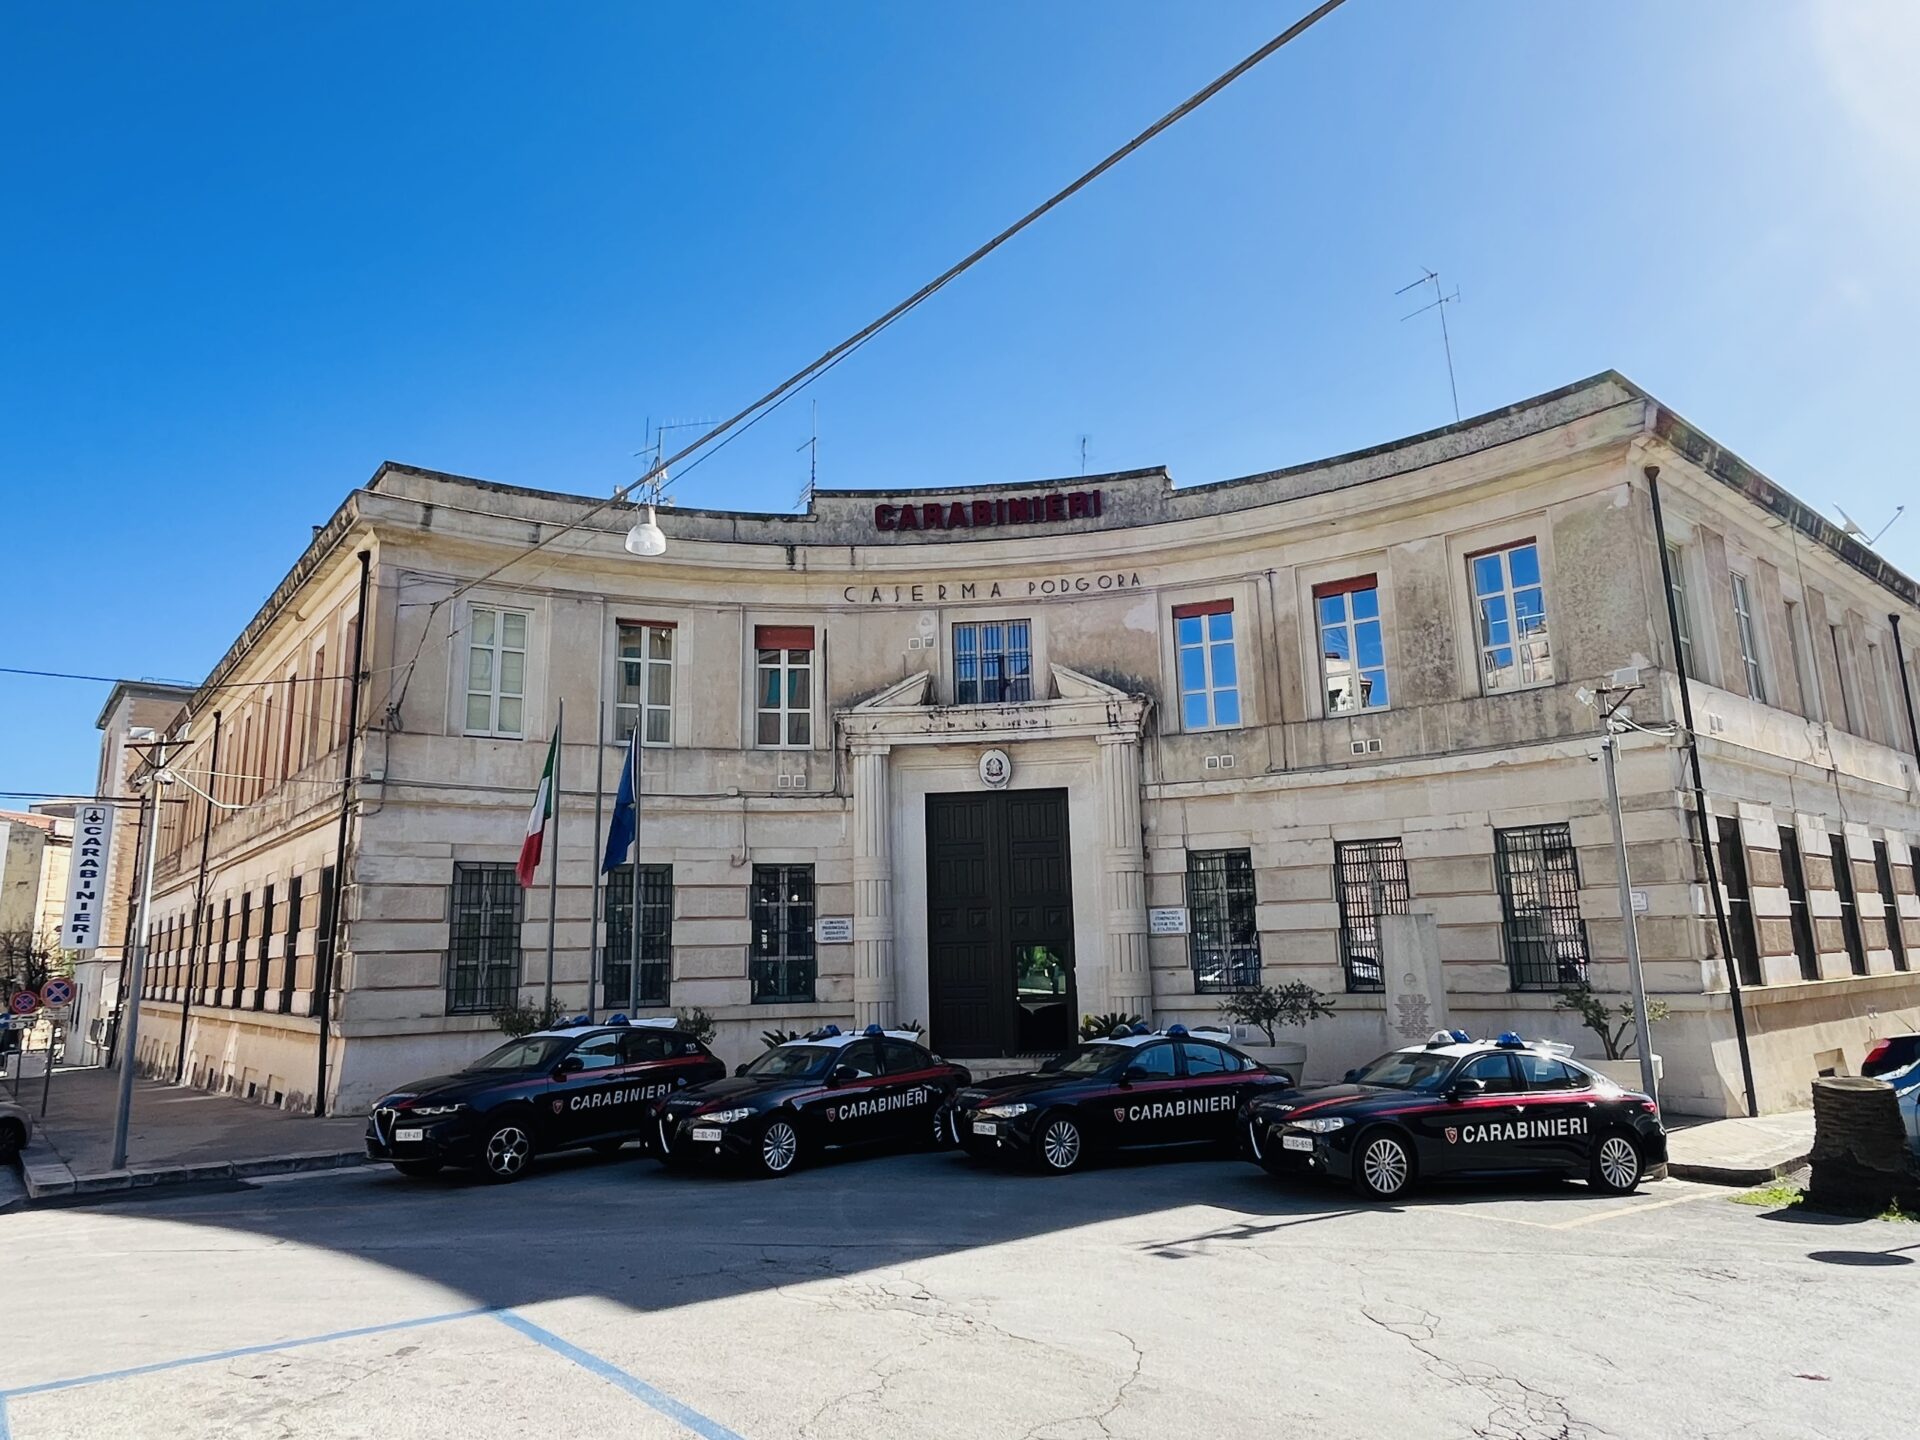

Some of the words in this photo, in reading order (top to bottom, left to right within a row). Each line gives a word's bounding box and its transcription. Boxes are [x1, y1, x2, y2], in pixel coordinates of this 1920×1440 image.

[874, 489, 1101, 531] CARABINIERI
[843, 582, 1001, 602] CASERMA
[1028, 573, 1140, 595] PODGORA
[71, 826, 102, 944] CARABINIERI
[570, 1083, 672, 1111] CARABINIERI
[839, 1089, 928, 1120] CARABINIERI
[1129, 1095, 1236, 1121] CARABINIERI
[1462, 1117, 1588, 1143] CARABINIERI
